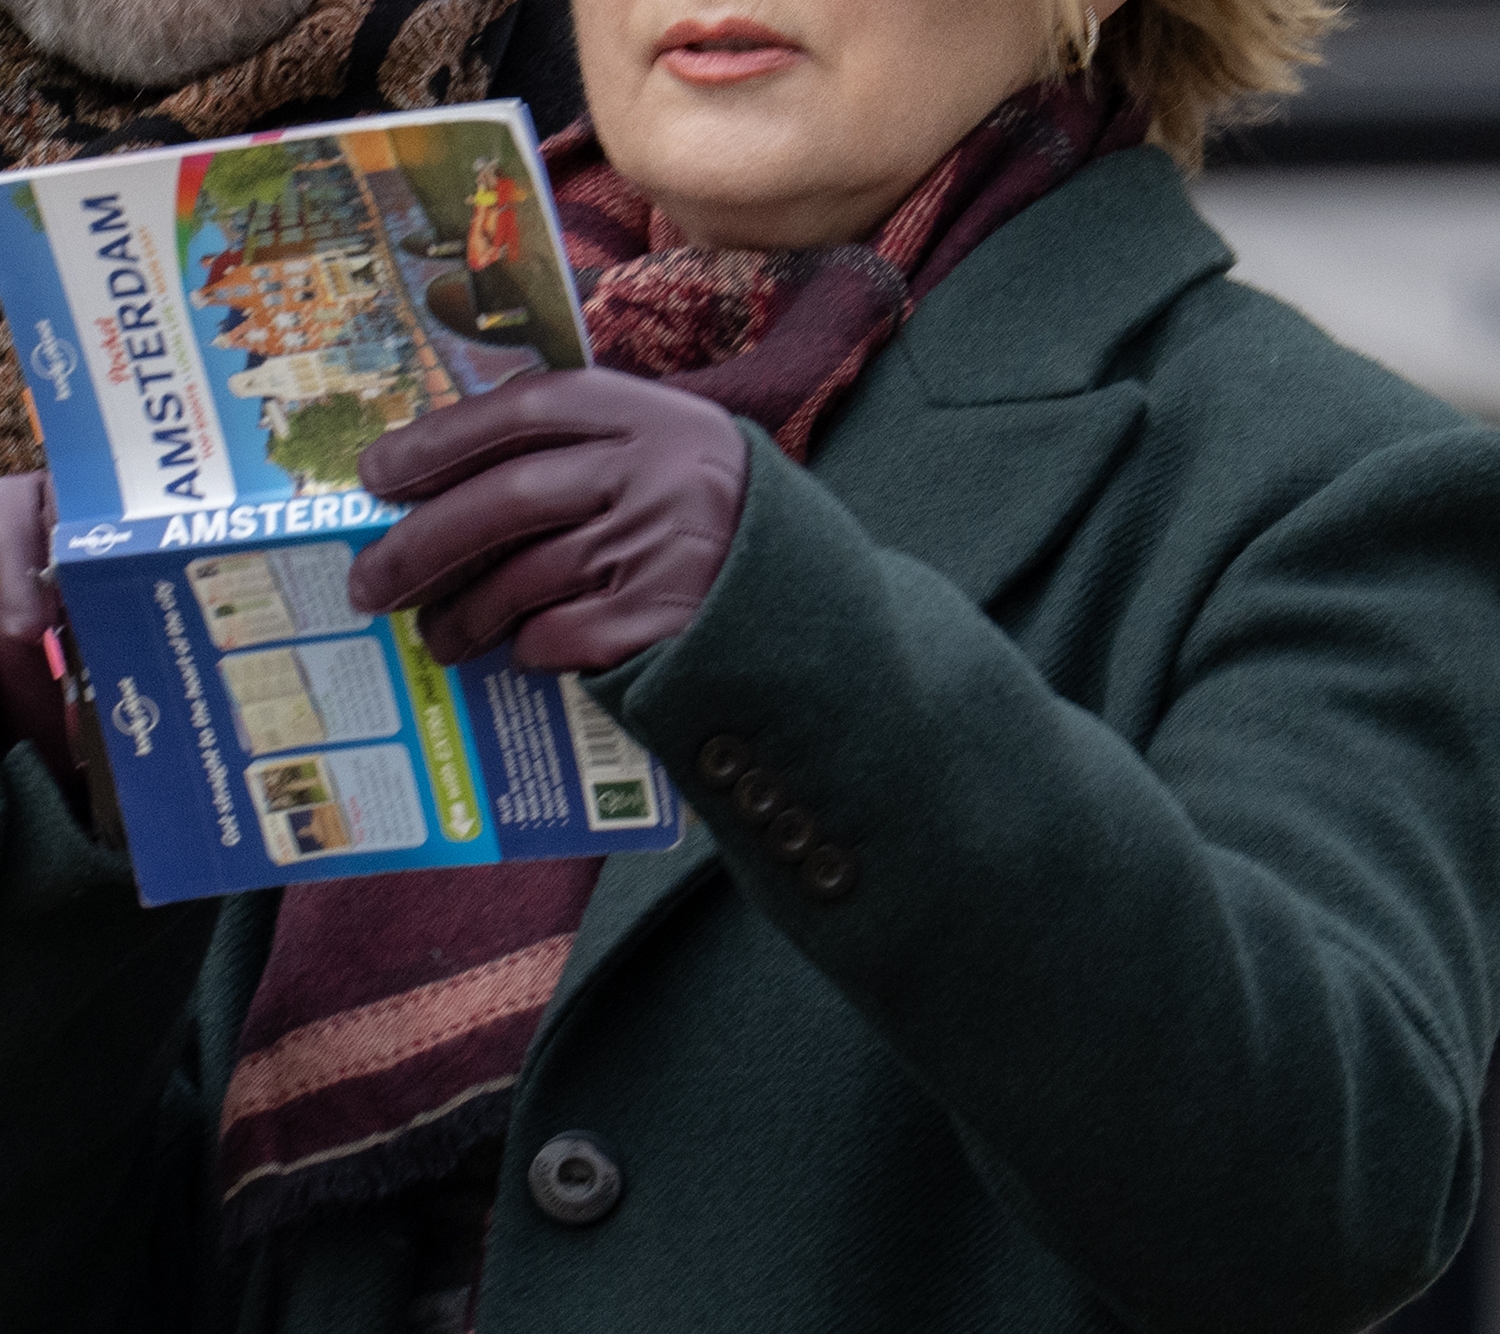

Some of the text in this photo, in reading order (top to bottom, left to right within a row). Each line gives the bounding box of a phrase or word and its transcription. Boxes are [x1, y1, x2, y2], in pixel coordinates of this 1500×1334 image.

[81, 193, 204, 501] AMSTERDAM
[154, 579, 242, 847] Get straight to the heart of the city
